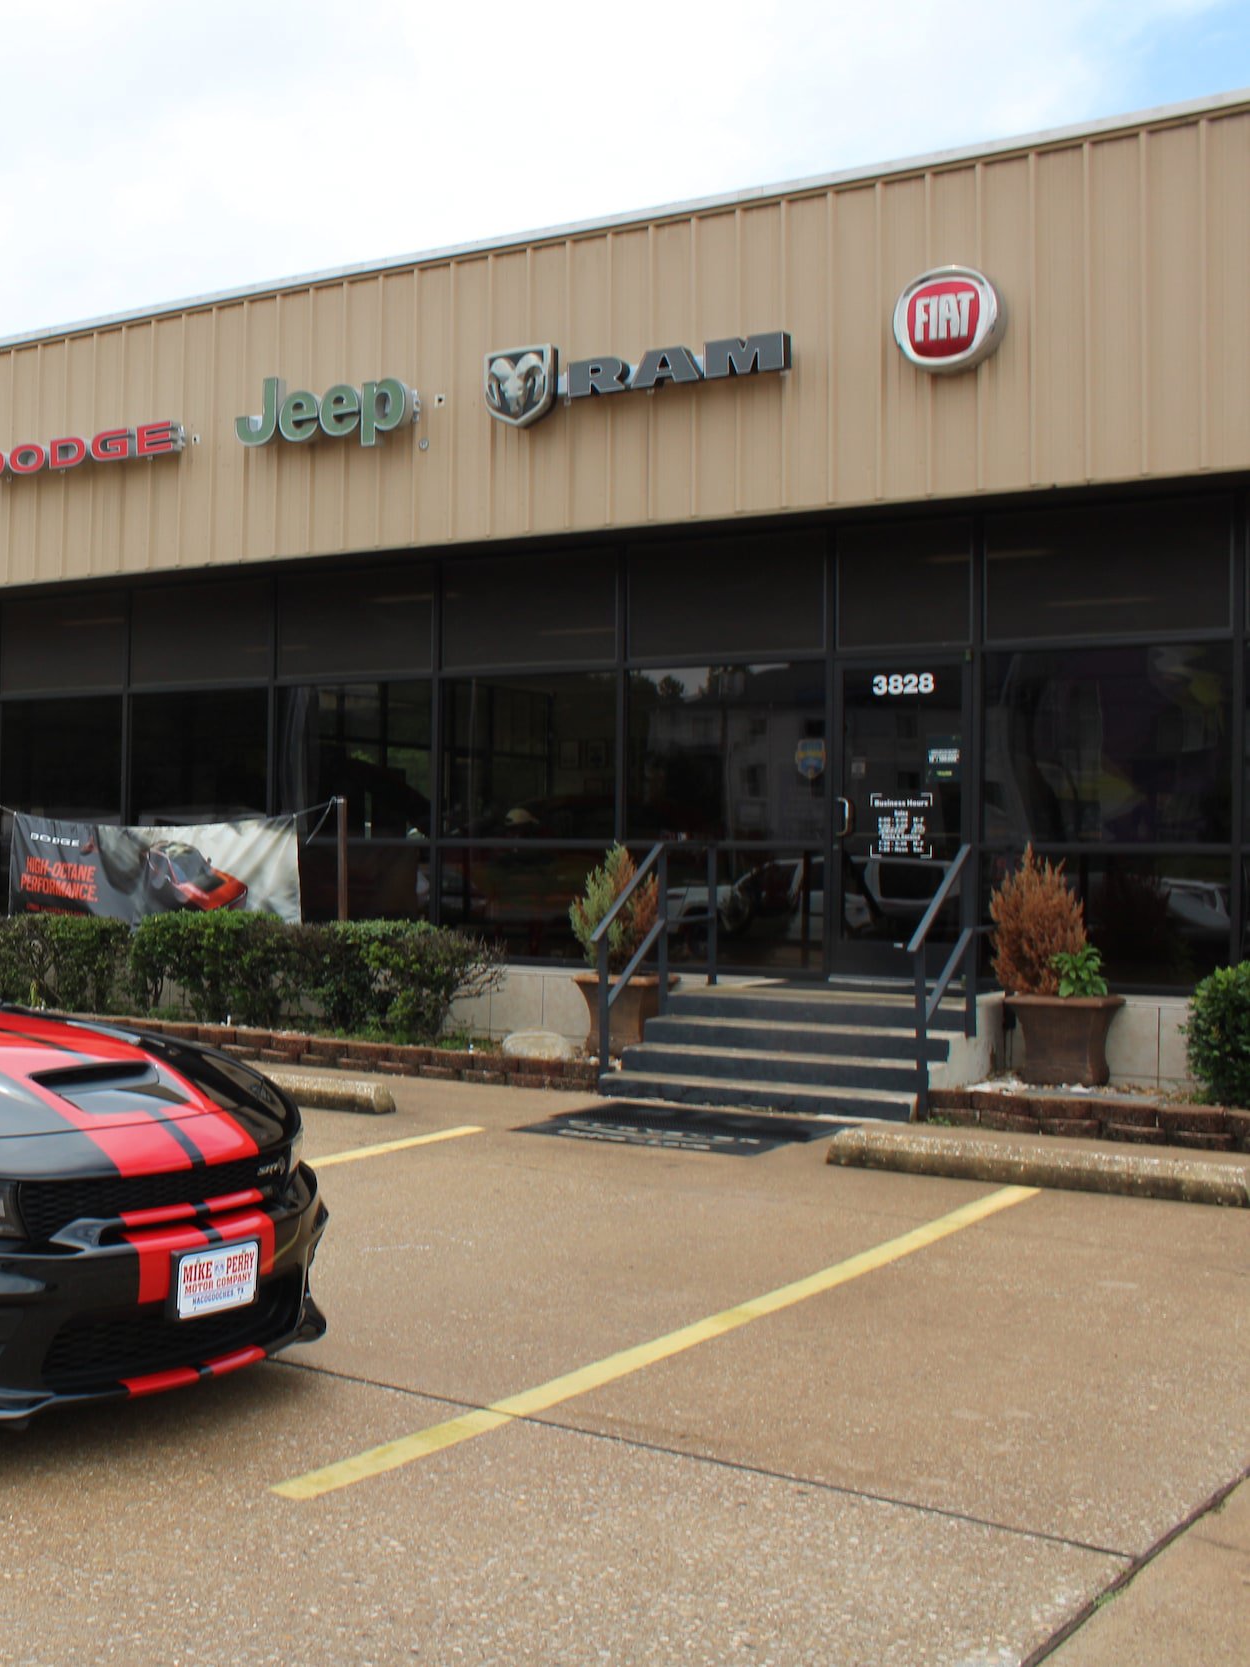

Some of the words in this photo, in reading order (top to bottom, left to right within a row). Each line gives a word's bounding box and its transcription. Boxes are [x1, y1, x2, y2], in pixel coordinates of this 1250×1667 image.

[914, 291, 975, 343] FIAT
[567, 331, 788, 398] RAM
[234, 376, 408, 448] Jeep
[872, 672, 935, 697] 3828
[26, 856, 96, 883] HIGH-OCTANE
[20, 872, 98, 903] PERFORMANCE.
[183, 1260, 213, 1285] MIKE
[226, 1250, 255, 1276] PERRY
[184, 1280, 214, 1296] MOTOR
[216, 1272, 252, 1289] COMPANY
